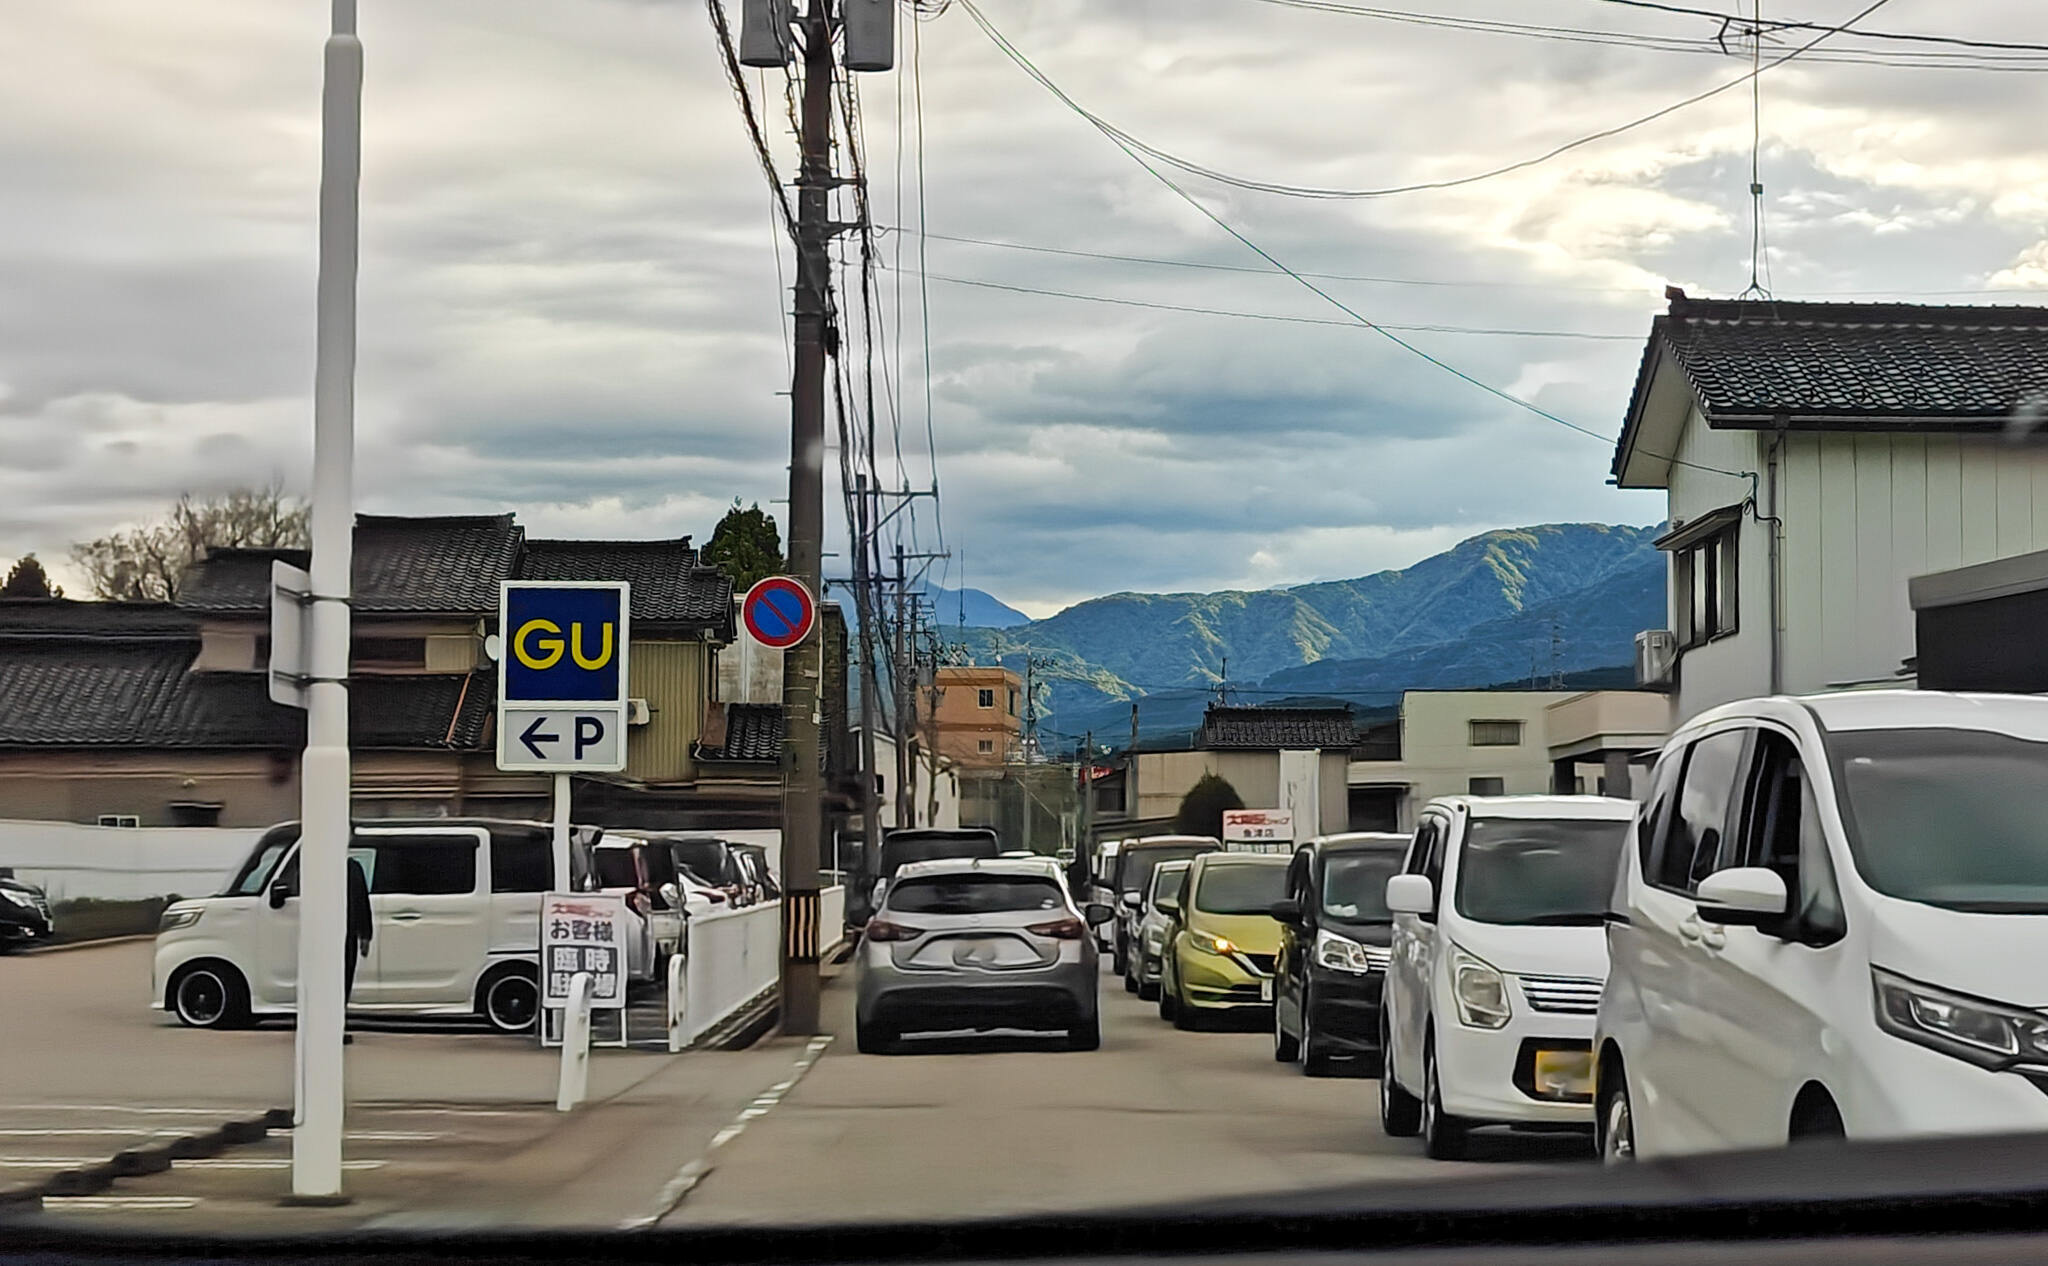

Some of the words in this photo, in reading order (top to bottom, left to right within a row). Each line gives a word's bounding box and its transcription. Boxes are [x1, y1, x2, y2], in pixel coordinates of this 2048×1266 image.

[514, 619, 613, 670] GU
[575, 717, 604, 760] P
[550, 918, 613, 942] お客様
[553, 947, 610, 972] 臨時
[550, 972, 616, 997] 駐場
